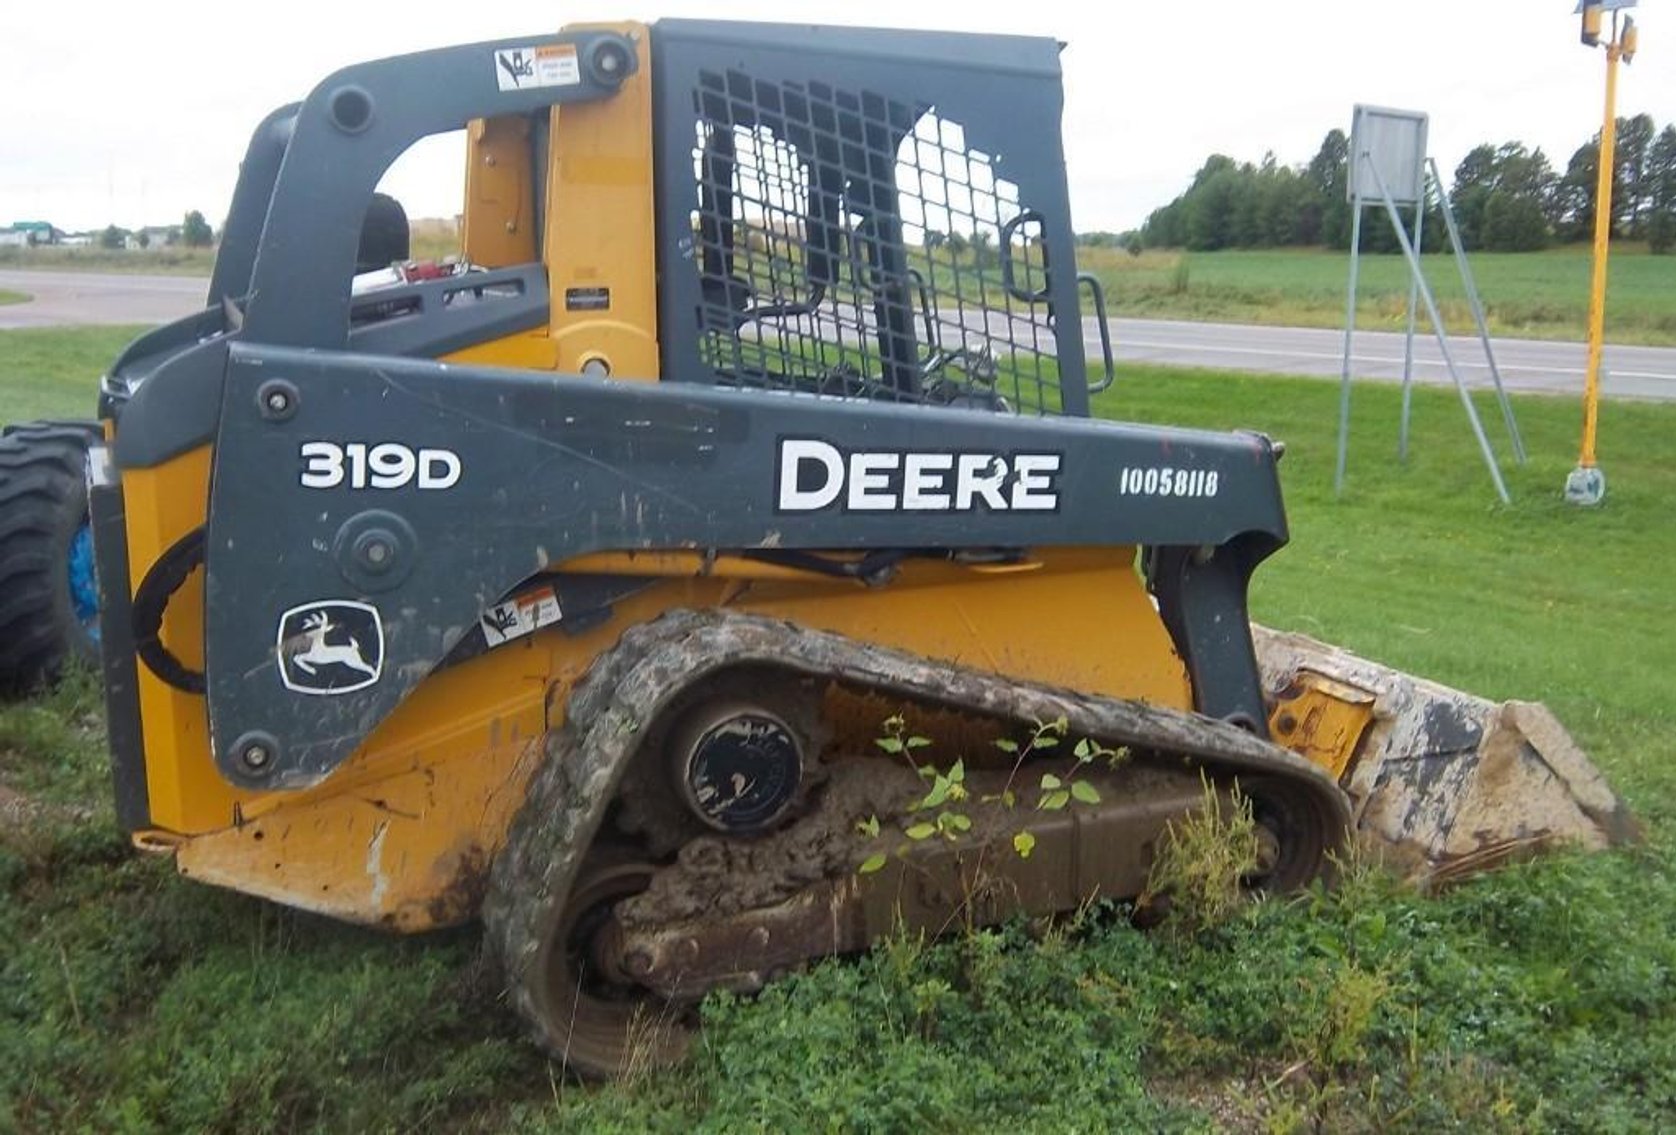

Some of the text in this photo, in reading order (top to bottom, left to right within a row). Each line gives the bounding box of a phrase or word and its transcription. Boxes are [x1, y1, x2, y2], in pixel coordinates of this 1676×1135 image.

[301, 442, 461, 488] 319D
[779, 440, 1060, 510] DEERE
[1120, 467, 1218, 497] 10058118
